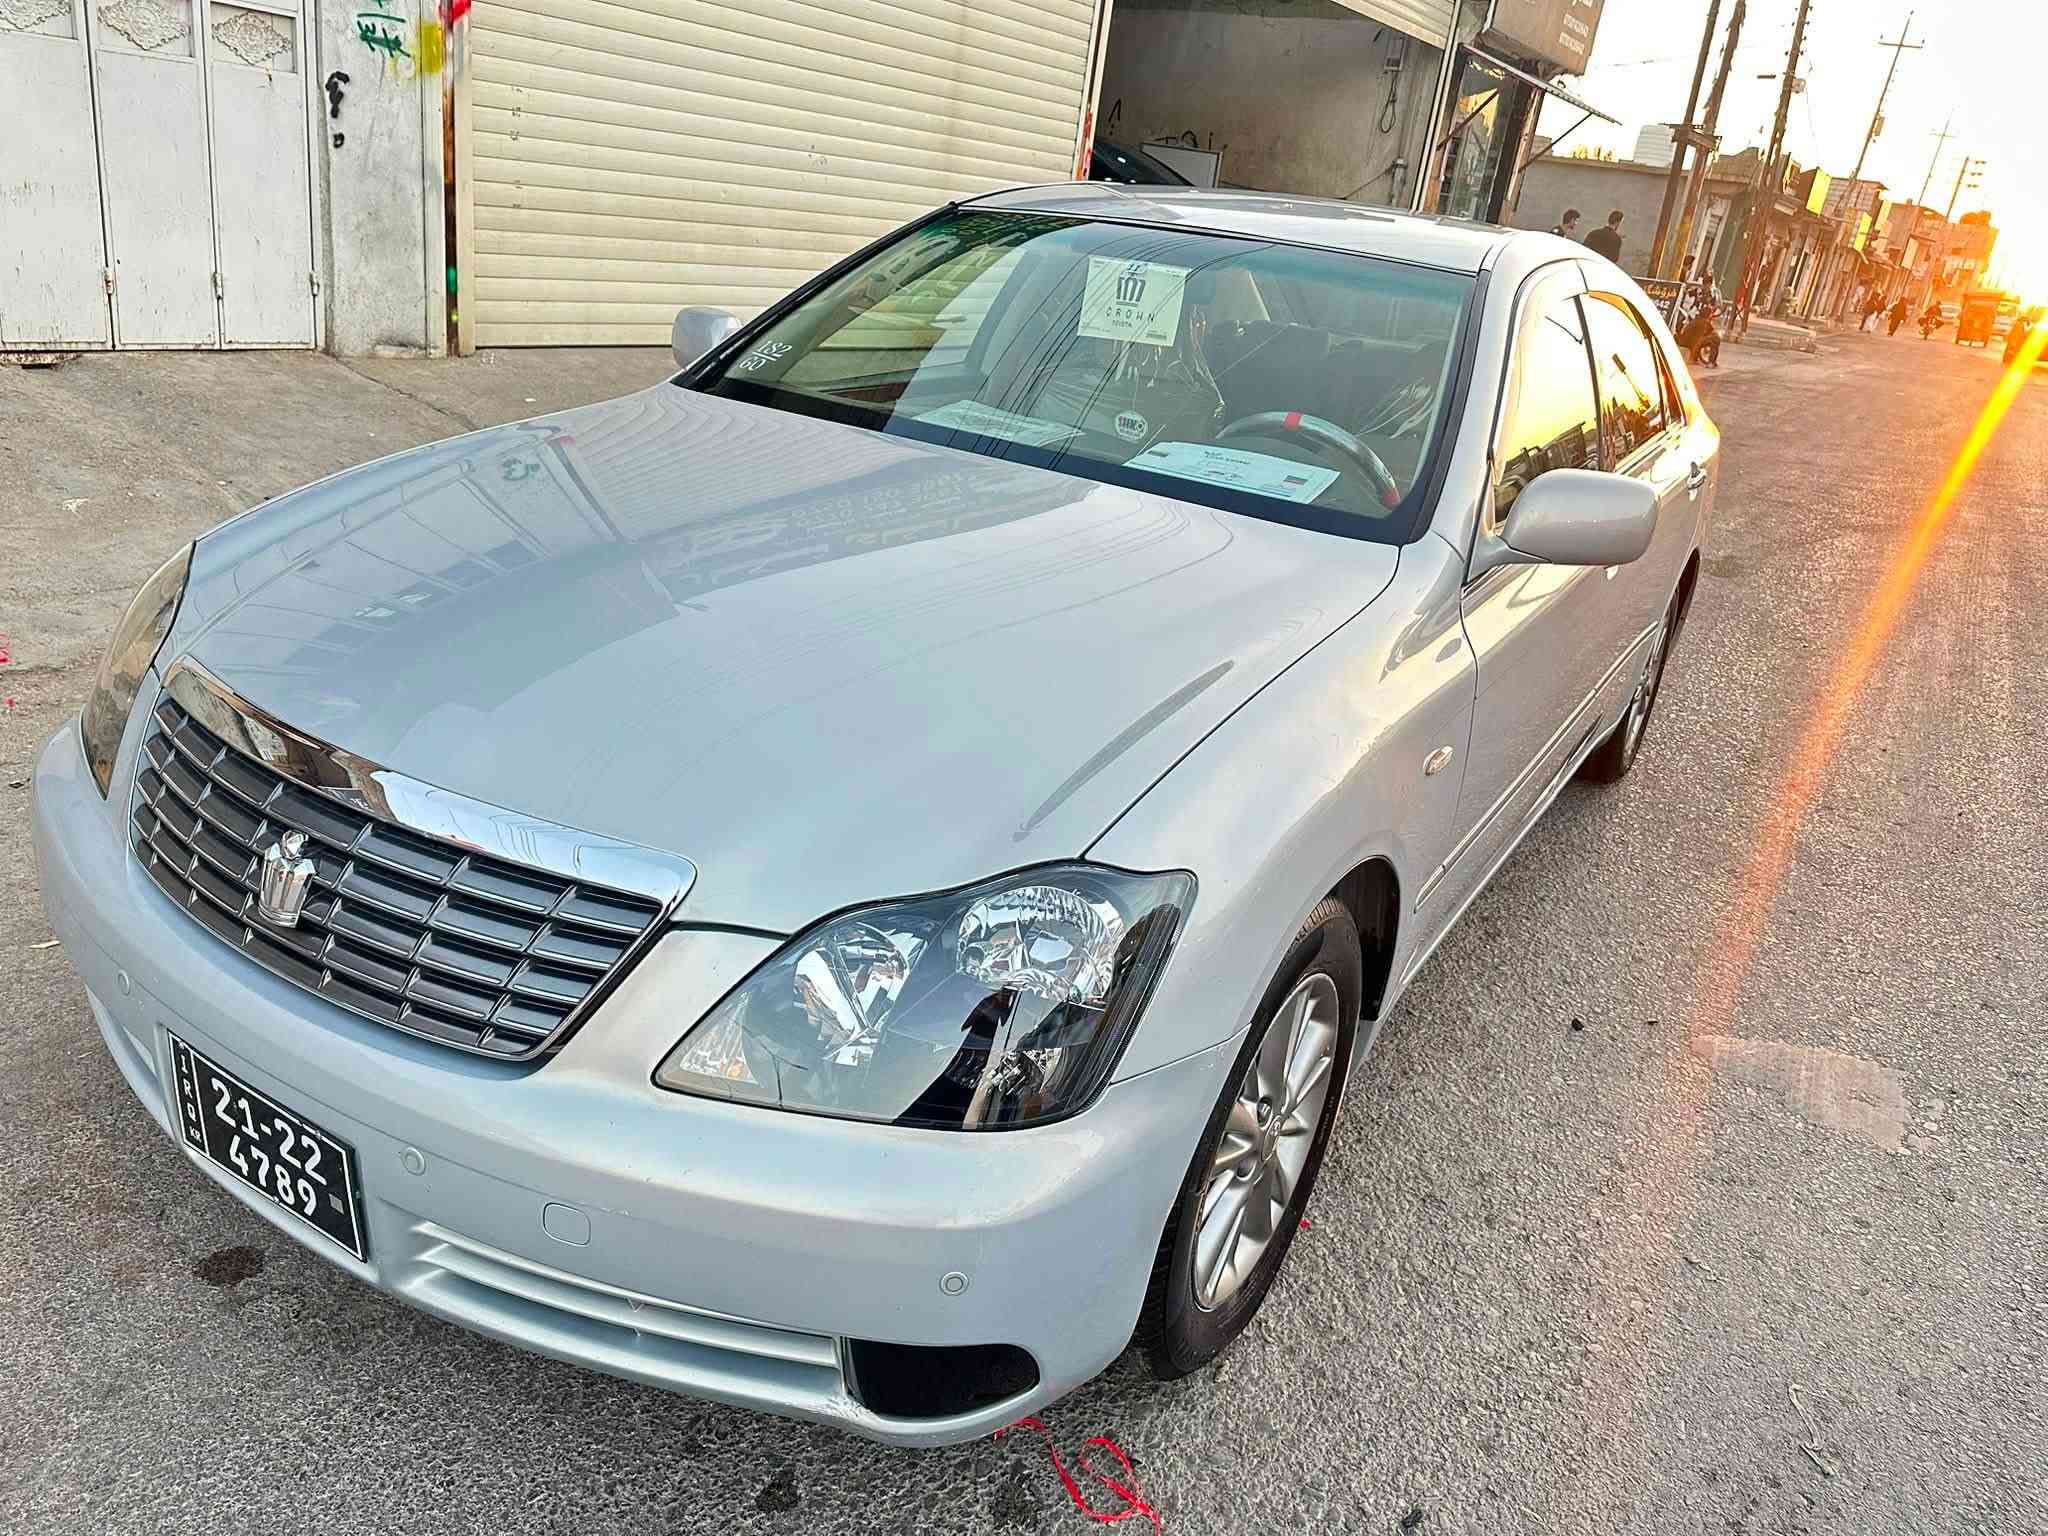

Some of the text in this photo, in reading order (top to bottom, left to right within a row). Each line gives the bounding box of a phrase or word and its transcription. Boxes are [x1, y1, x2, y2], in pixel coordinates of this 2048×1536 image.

[1104, 305, 1156, 322] CROWN
[210, 1077, 328, 1187] 21-22
[228, 1135, 318, 1217] 4789
